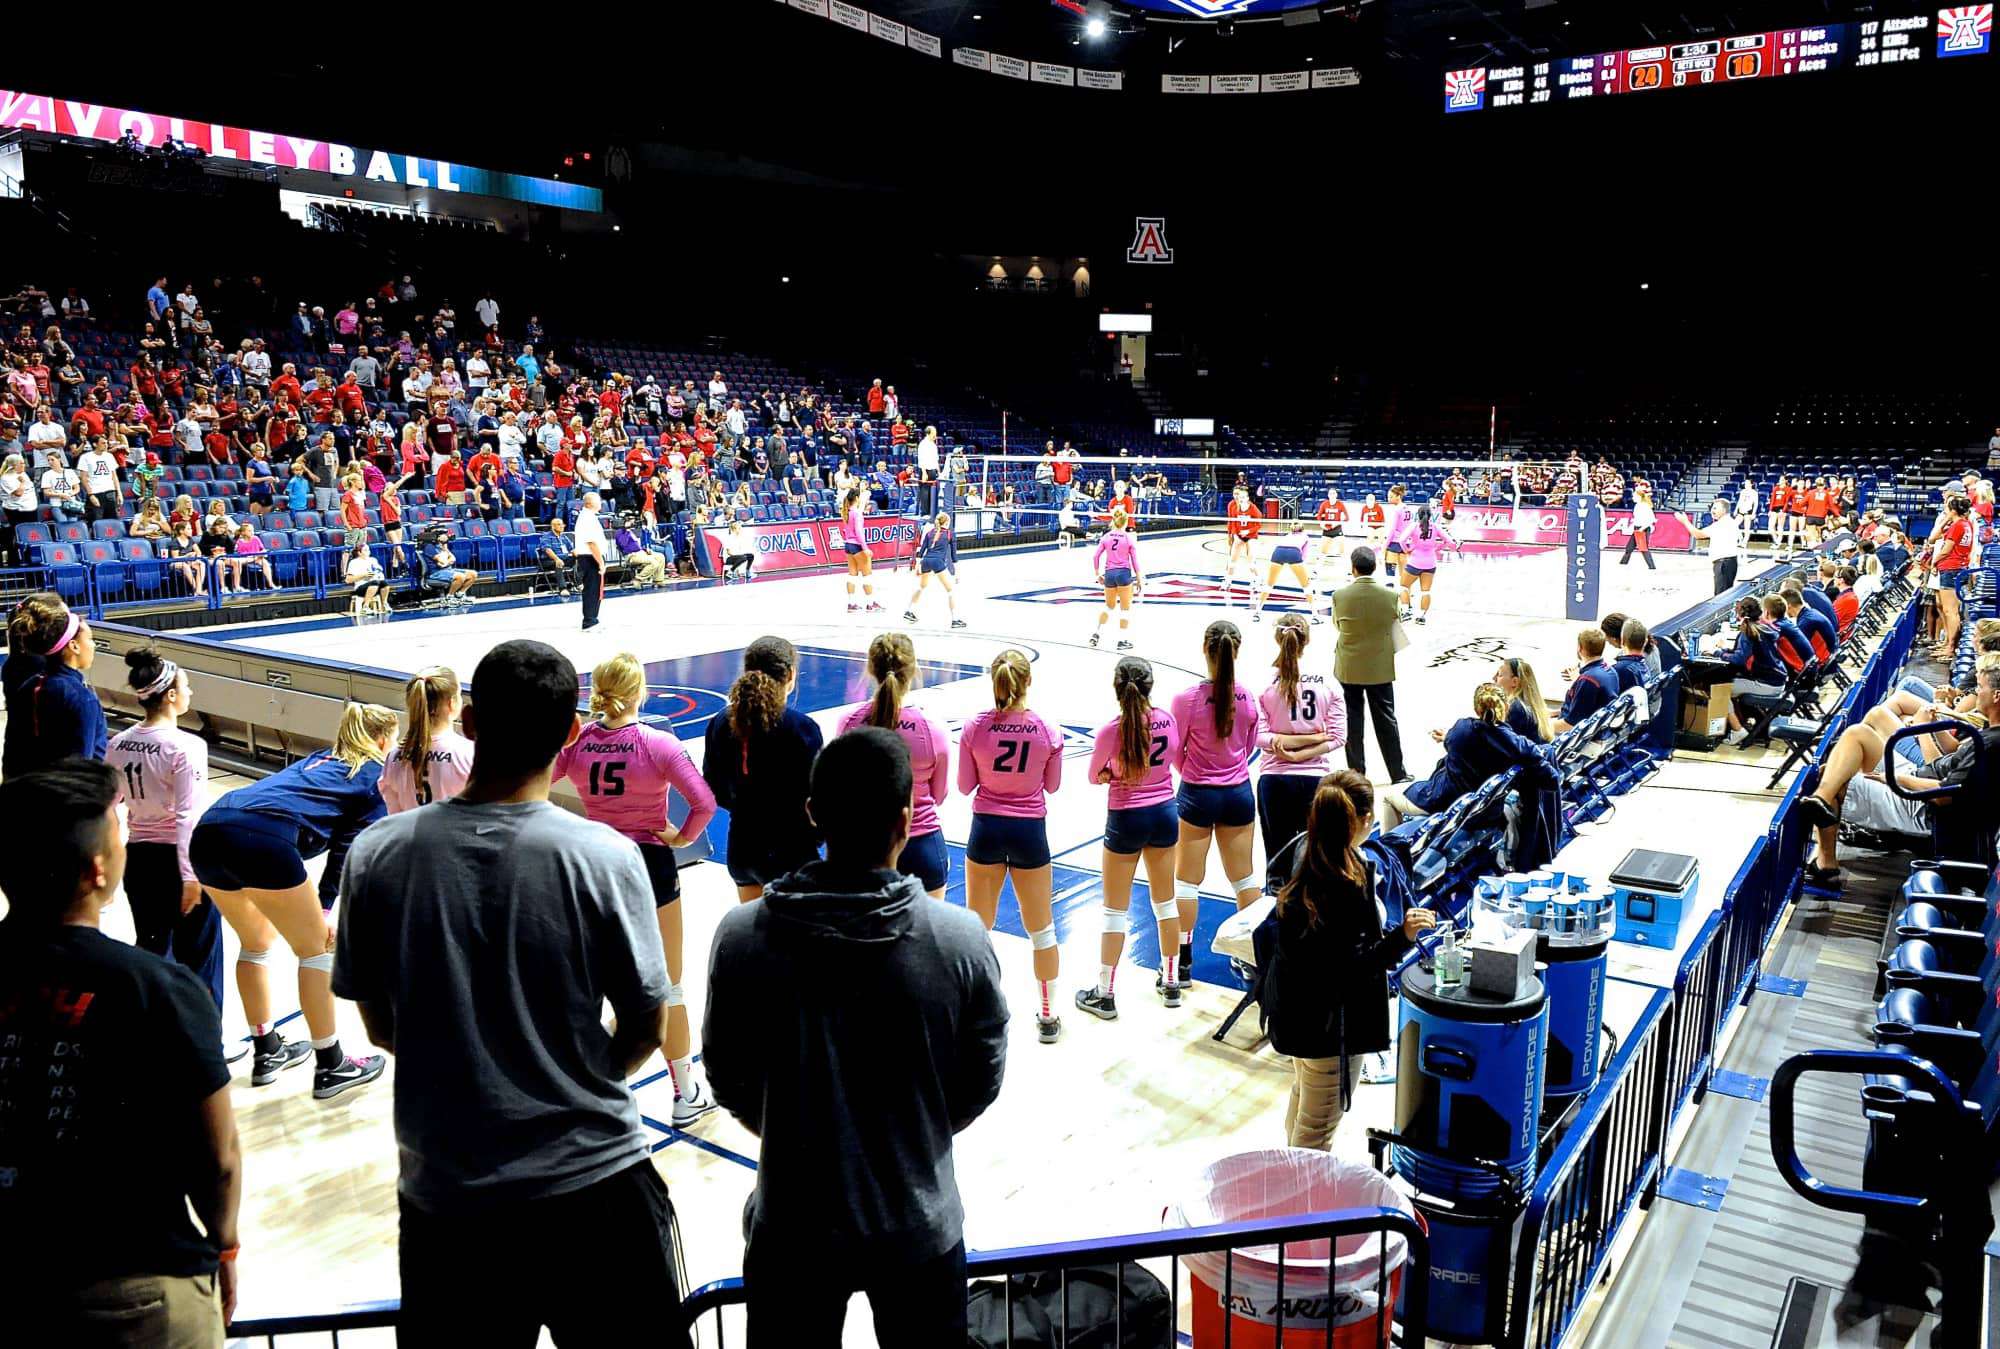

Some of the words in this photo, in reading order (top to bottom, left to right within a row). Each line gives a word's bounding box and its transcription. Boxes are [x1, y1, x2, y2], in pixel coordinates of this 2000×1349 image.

[1883, 16, 1928, 33] Attacks
[1800, 29, 1826, 42] Digs
[1882, 33, 1909, 47] Kills
[1681, 44, 1708, 57] 1:30
[1799, 42, 1838, 58] Blocks
[1489, 66, 1524, 80] Attacks
[1572, 58, 1594, 71] Digs
[1732, 54, 1755, 76] 16
[1799, 58, 1826, 72] Aces
[1559, 71, 1592, 85] Blocks
[1634, 66, 1657, 88] 24
[1503, 80, 1524, 92] Kills
[1568, 85, 1593, 98] Aces
[62, 100, 460, 192] VOLLEYBALL
[1127, 217, 1173, 263] A
[864, 523, 914, 544] LDCATS
[1111, 538, 1119, 551] 2
[1575, 508, 1588, 603] WILDCATS
[1289, 689, 1317, 721] 13
[988, 723, 1038, 735] ARIZONA
[115, 739, 161, 756] ARIZONA
[581, 742, 635, 754] ARIZONA
[992, 740, 1031, 774] 21
[123, 761, 145, 800] 11
[589, 761, 627, 797] 15
[1582, 965, 1600, 1079] POWERADE
[1521, 1024, 1537, 1150] POWERADE
[1429, 1265, 1481, 1286] RADE
